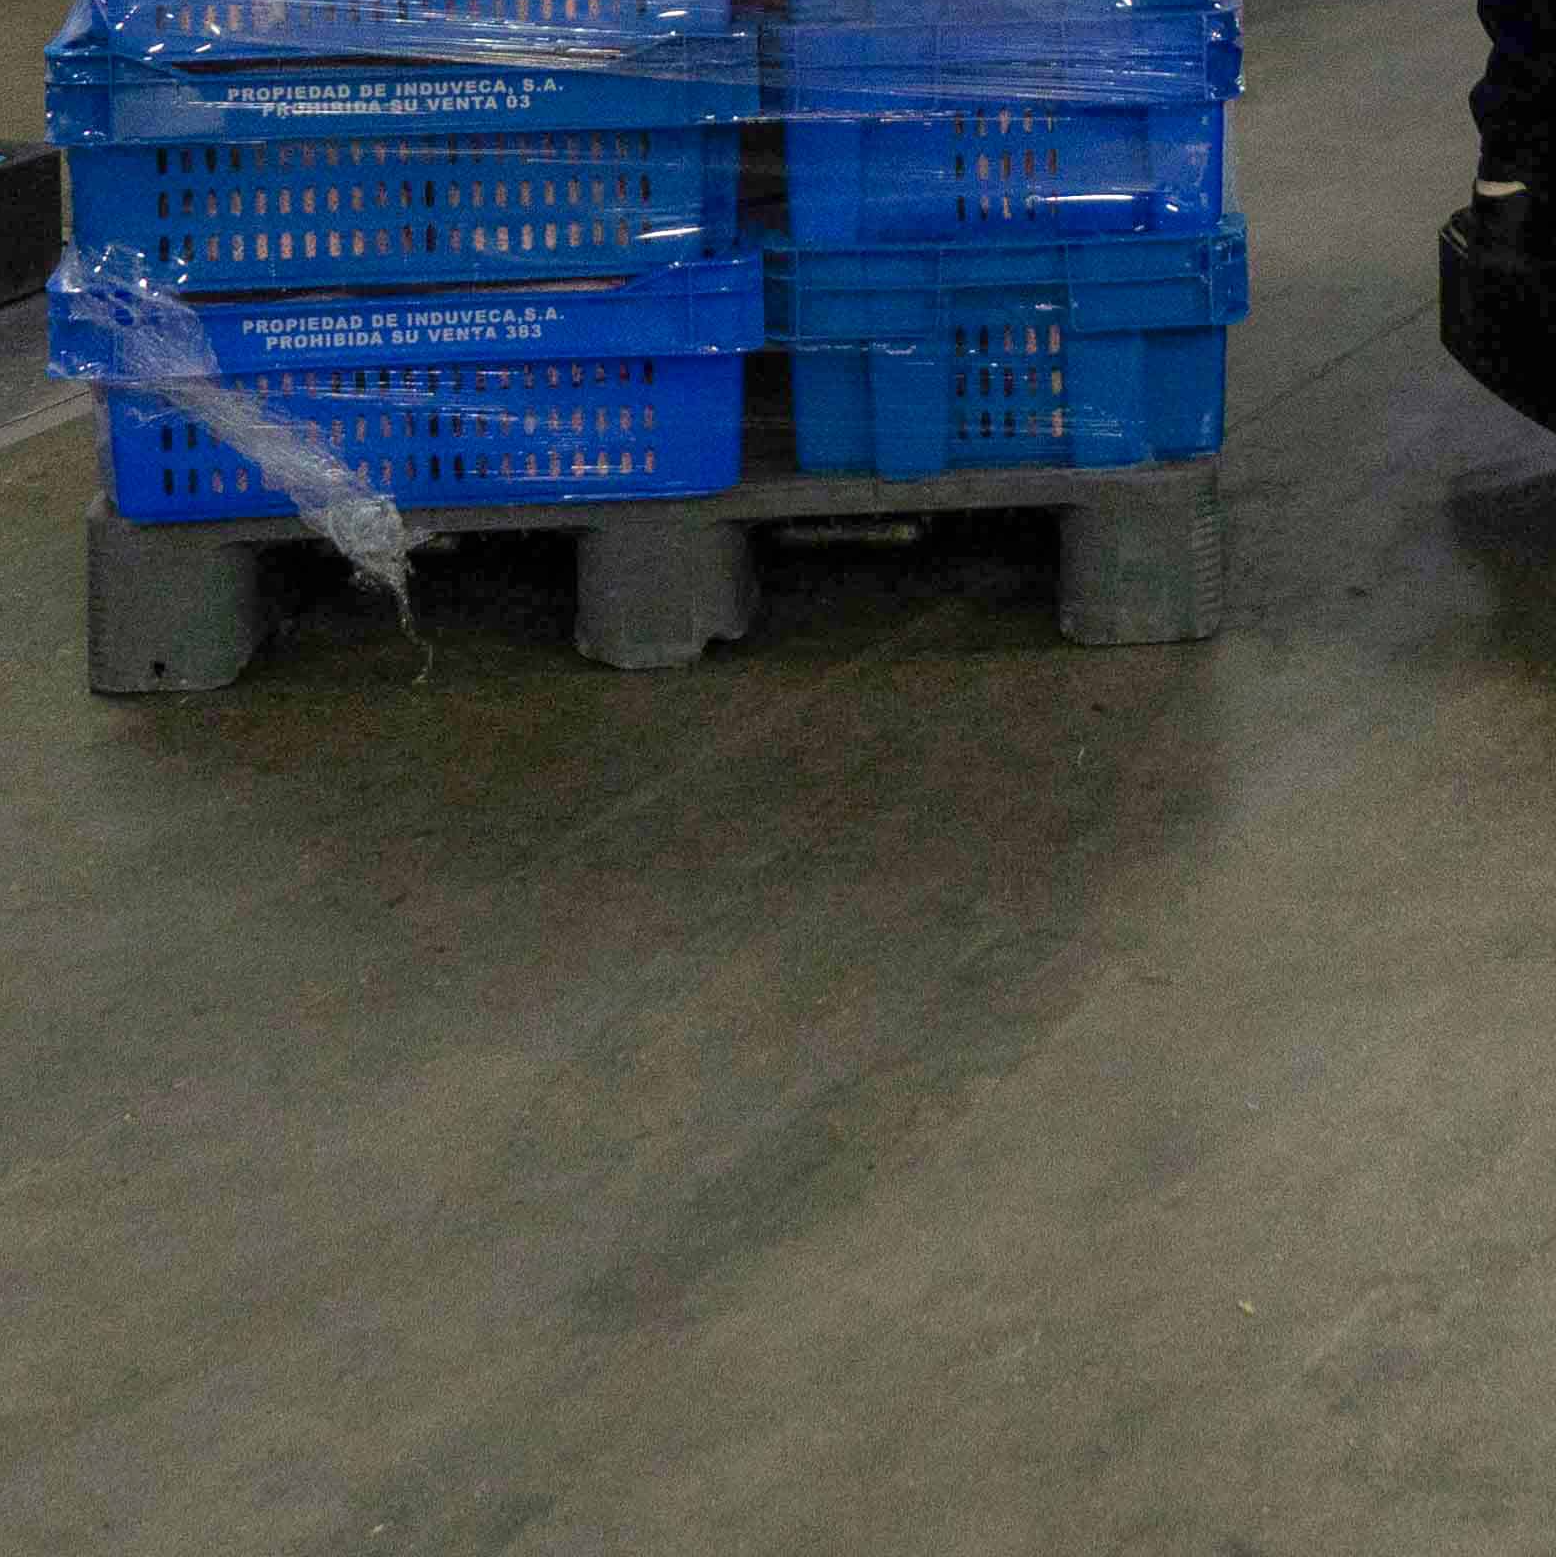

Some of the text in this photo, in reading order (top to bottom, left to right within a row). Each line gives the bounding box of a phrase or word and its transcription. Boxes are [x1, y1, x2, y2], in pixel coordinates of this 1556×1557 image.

[227, 77, 565, 102] PROPIEDAD DE INDUVECA, S.A.
[262, 94, 531, 119] PROHIBIDA SU VENTA 03
[242, 307, 565, 334] PROPIEDAD DE INDUVECA,S.A.
[266, 324, 543, 350] PROHIBIDA SU VENTA 383
